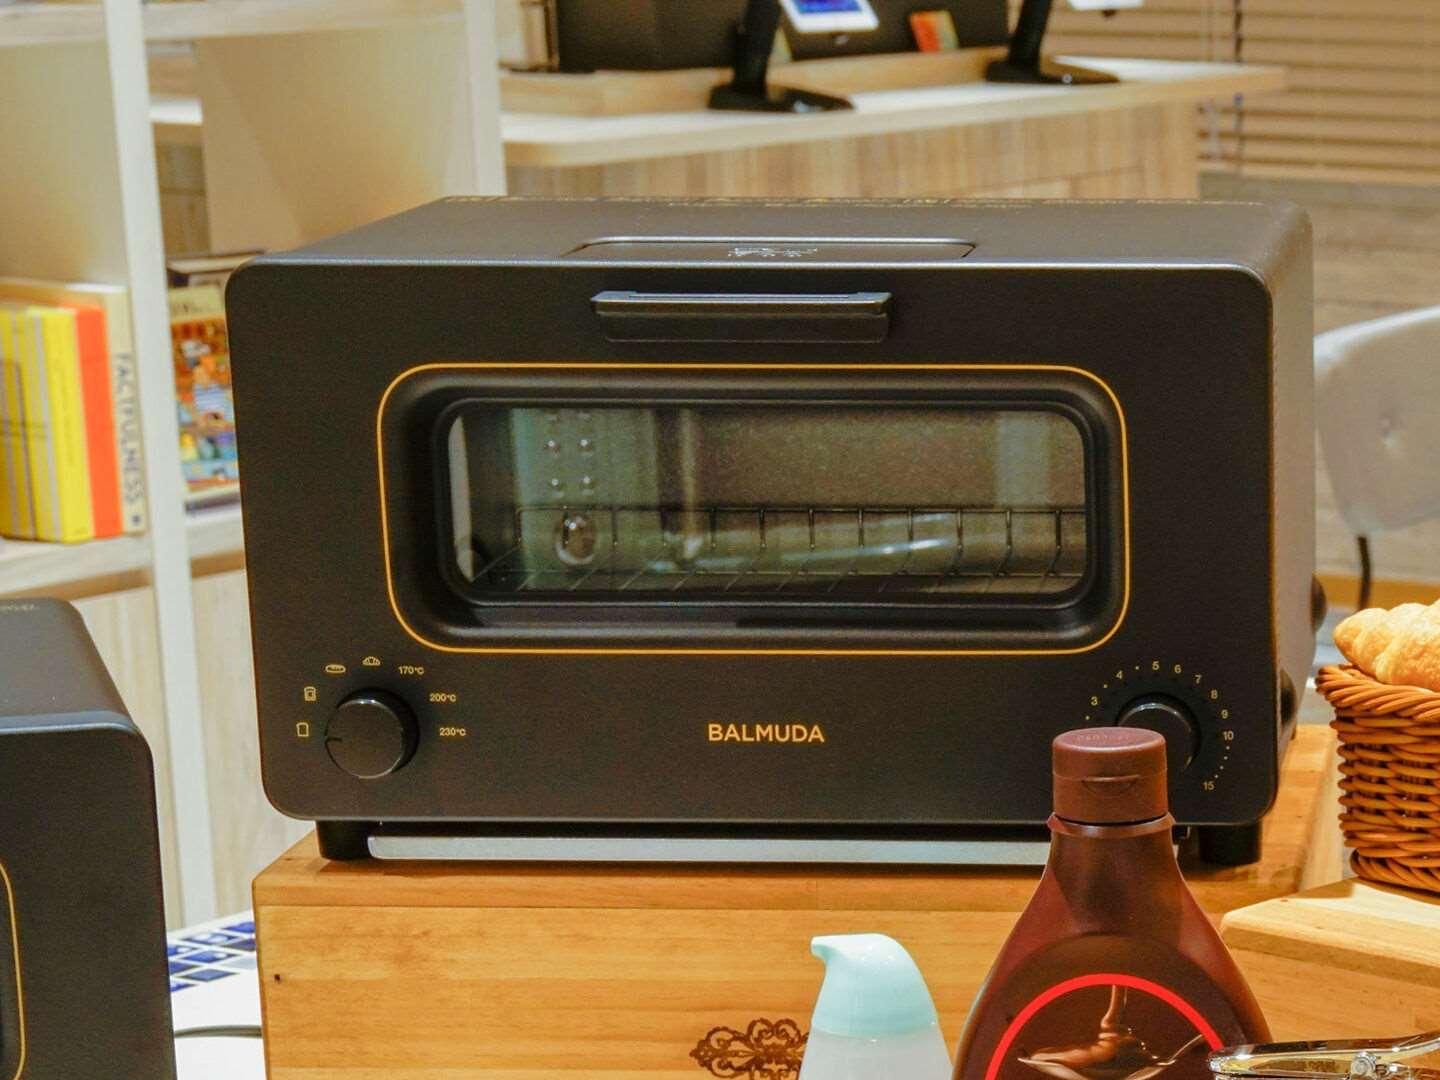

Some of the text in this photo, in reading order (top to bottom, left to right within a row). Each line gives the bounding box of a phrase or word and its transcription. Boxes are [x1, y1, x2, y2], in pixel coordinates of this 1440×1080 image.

[1152, 661, 1160, 671] 5
[1174, 664, 1182, 674] 6
[1115, 670, 1124, 680] 4
[1194, 674, 1202, 684] 7
[1210, 689, 1218, 699] 8
[1090, 696, 1098, 706] 3
[1221, 710, 1229, 719] 9
[708, 723, 825, 742] BALMUDA
[1223, 731, 1234, 741] 10
[1203, 781, 1215, 791] 15
